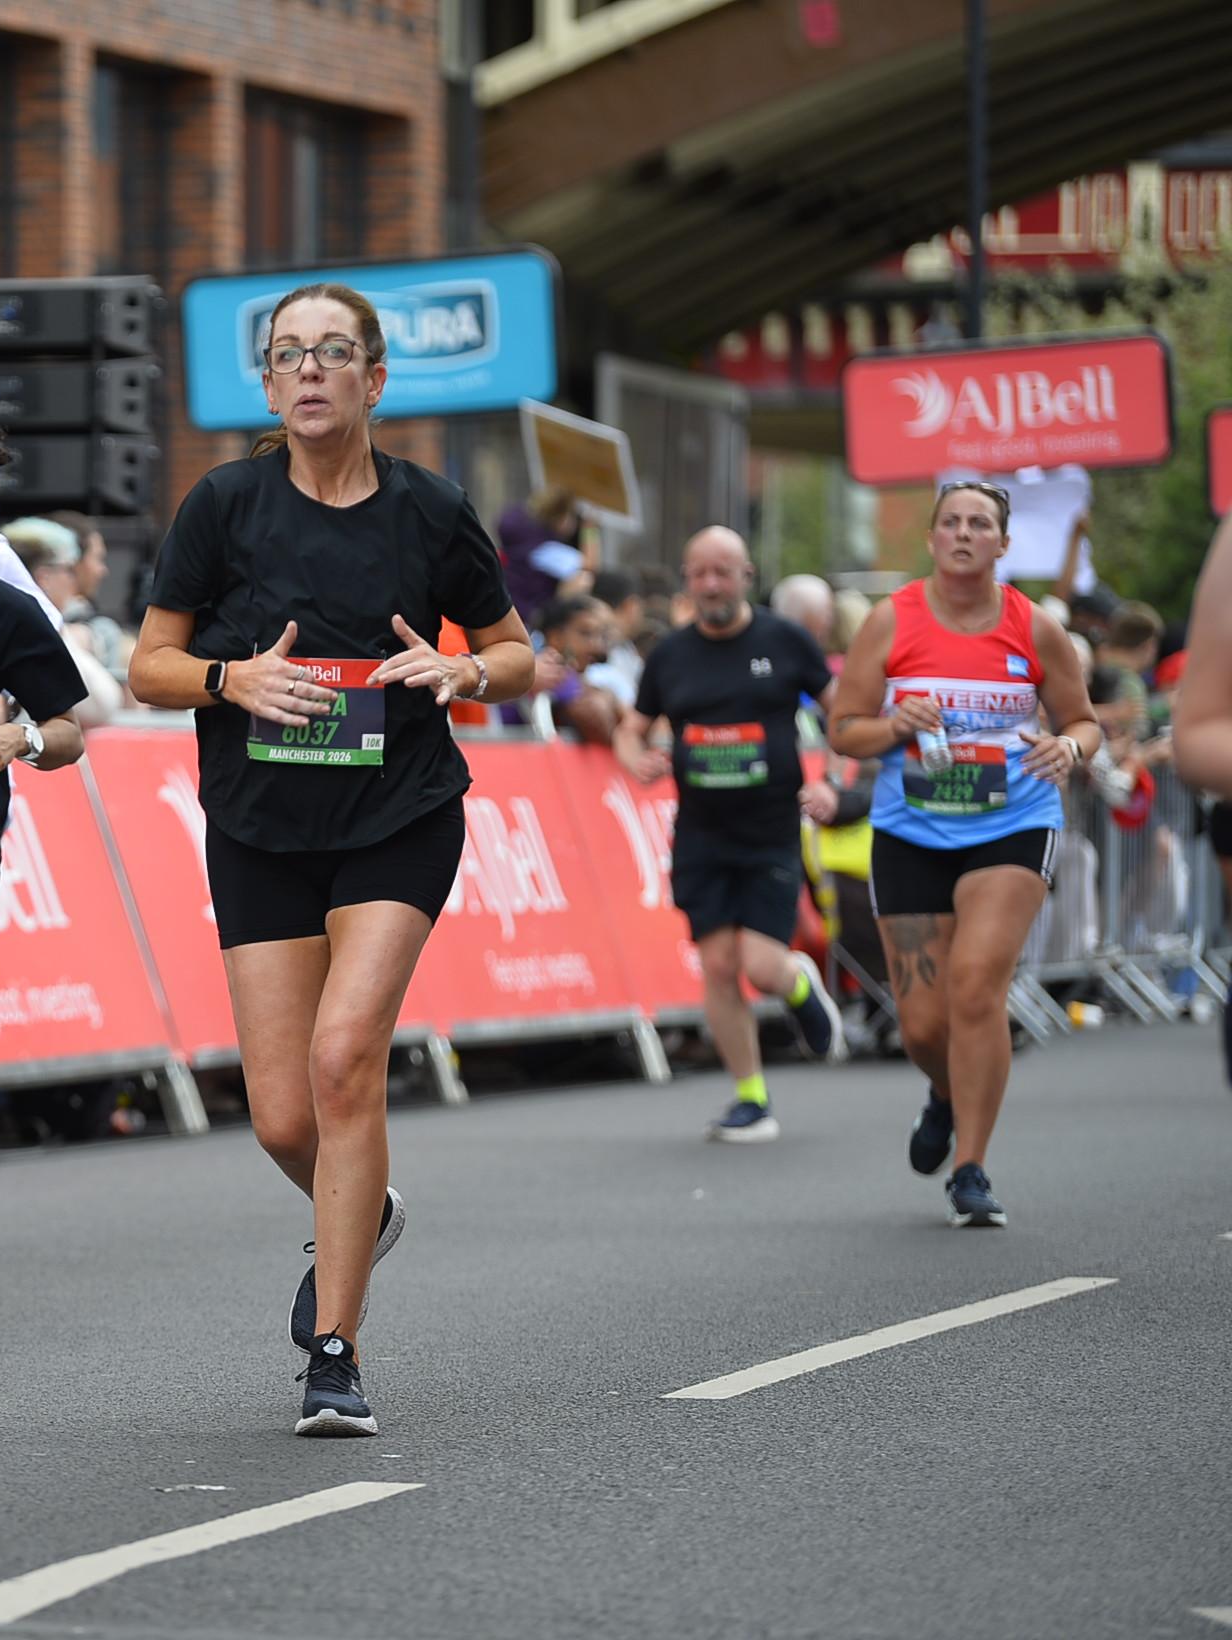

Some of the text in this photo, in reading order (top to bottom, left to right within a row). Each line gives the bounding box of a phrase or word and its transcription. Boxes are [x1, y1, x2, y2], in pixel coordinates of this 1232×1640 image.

[281, 720, 340, 746] 6037
[367, 737, 382, 748] 10K
[268, 748, 352, 763] MANCHESTER 2026
